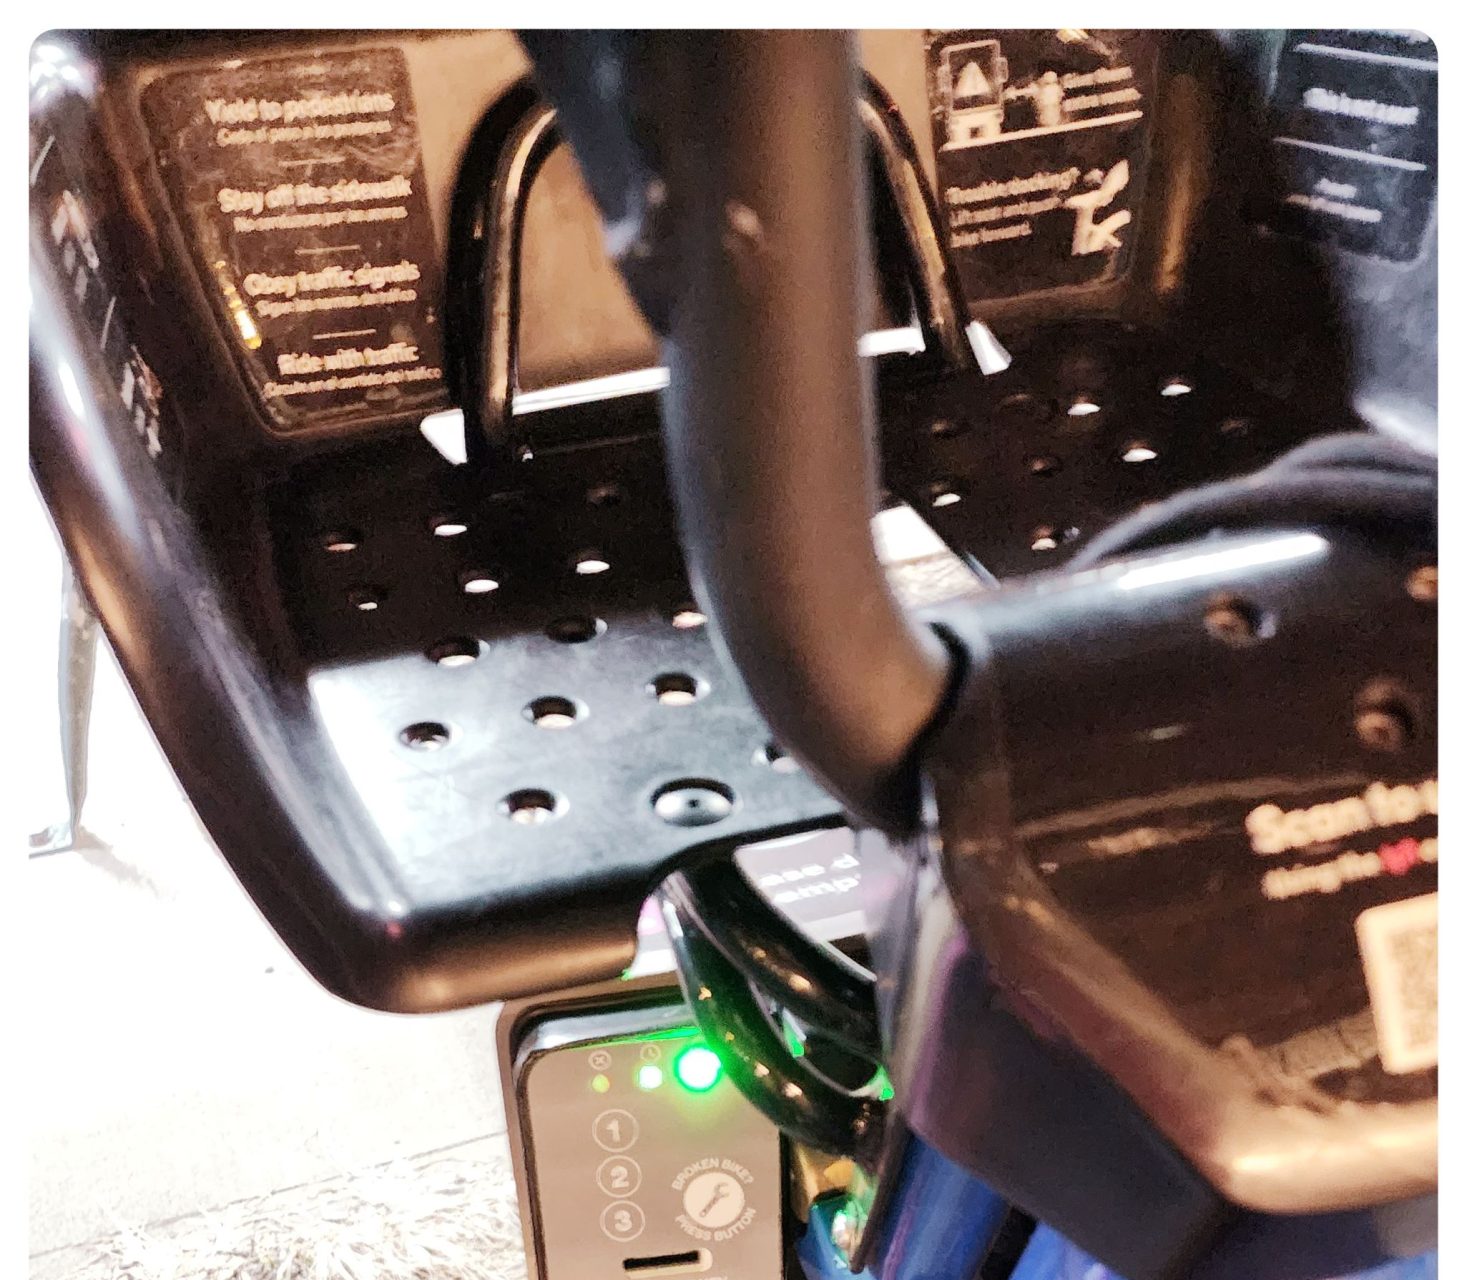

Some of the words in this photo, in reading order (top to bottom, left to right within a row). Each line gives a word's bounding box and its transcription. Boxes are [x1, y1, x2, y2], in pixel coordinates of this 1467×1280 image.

[218, 188, 264, 215] Stay
[605, 1119, 621, 1142] 1
[610, 1165, 630, 1189] 2
[671, 1157, 720, 1191] BROKEN
[613, 1210, 633, 1232] 3
[675, 1213, 712, 1241] PRESS
[713, 1206, 757, 1242] BUTTON
